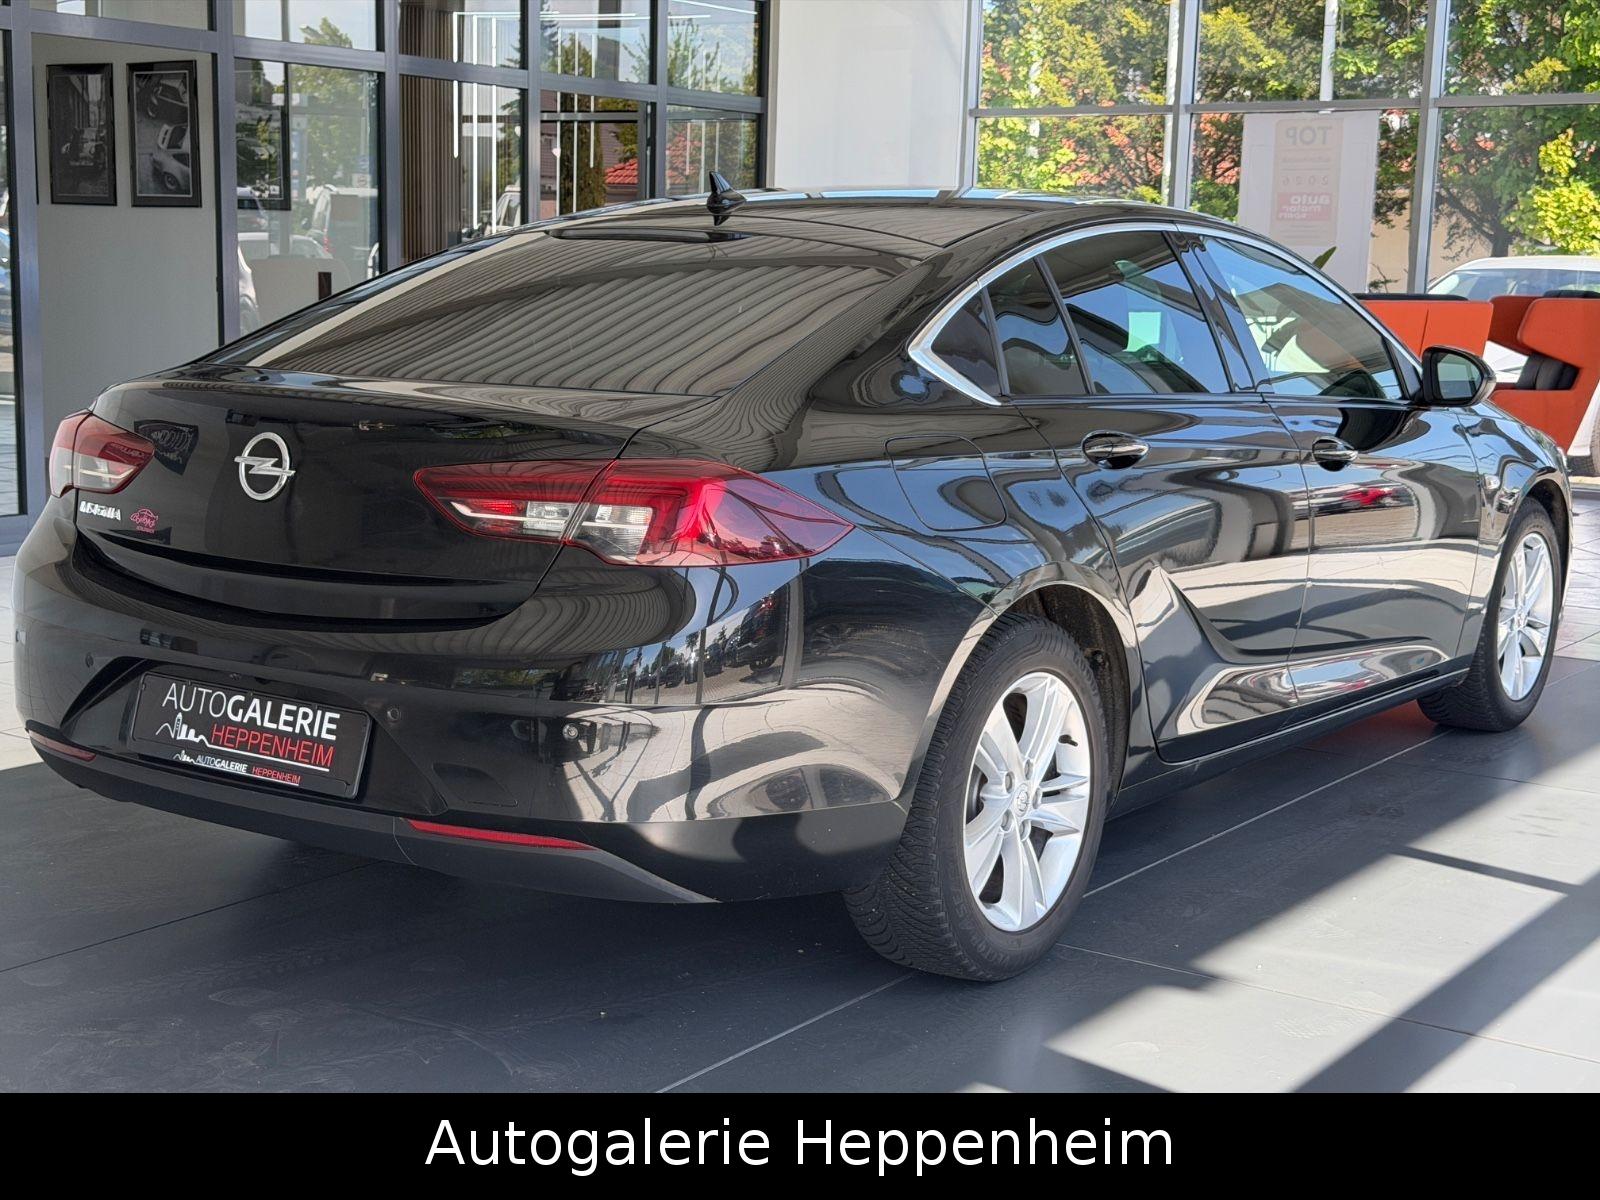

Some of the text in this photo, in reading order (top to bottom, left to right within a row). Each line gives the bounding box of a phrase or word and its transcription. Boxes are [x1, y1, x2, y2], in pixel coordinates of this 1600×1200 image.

[162, 682, 341, 741] AUTOGALERIE
[210, 723, 335, 768] HEPPENHEIM
[195, 754, 302, 785] AUTOGALERIE HEPPENHEIM
